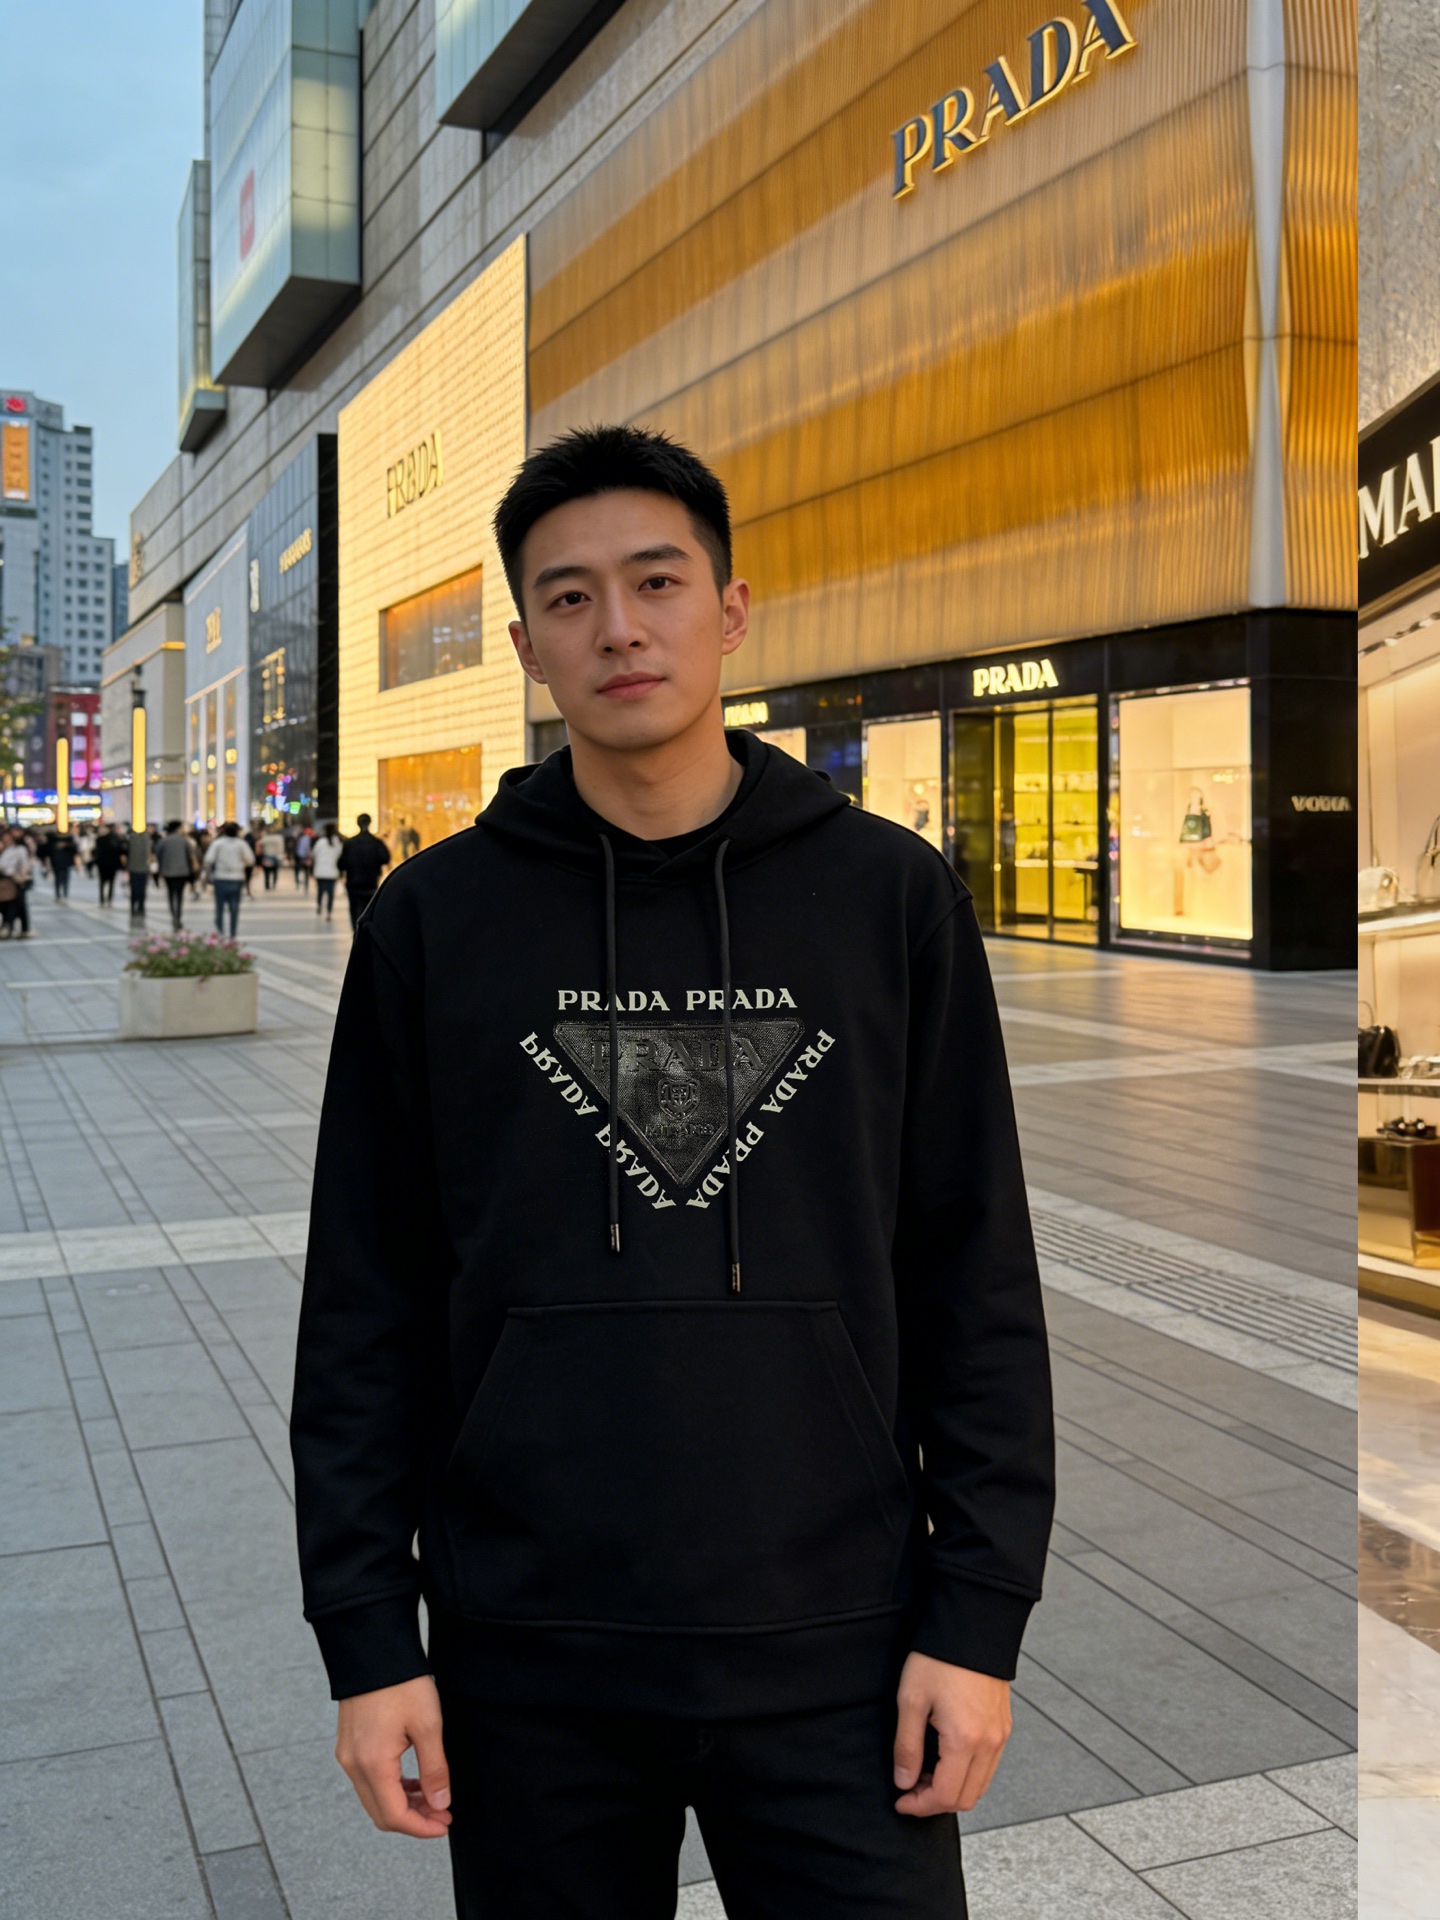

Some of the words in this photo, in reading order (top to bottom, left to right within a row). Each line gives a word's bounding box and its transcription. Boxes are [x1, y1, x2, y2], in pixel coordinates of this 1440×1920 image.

[890, 0, 1138, 200] PRADA
[972, 658, 1059, 697] PRADA
[557, 989, 670, 1011] PRADA
[685, 987, 798, 1011] PRADA
[759, 1028, 836, 1114] PRADA
[685, 1120, 765, 1210] PRADA
